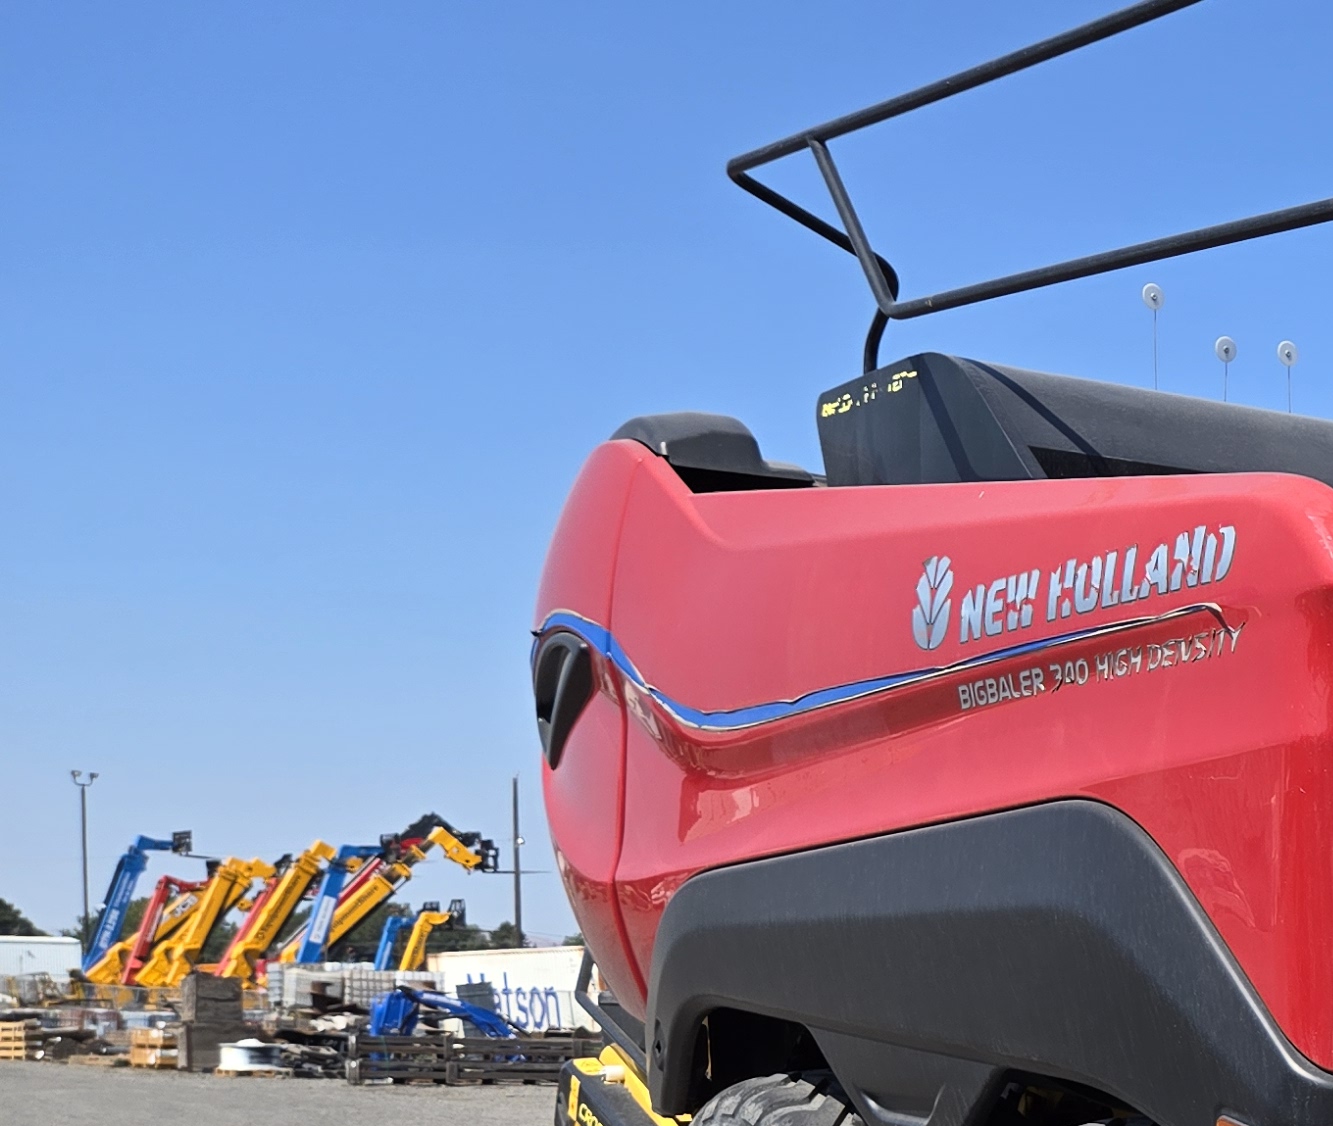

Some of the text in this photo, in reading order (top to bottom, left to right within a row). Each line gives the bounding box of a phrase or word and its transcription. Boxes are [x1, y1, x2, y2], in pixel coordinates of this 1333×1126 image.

[959, 524, 1237, 645] NEW HOLLAND
[958, 666, 1046, 710] BIGBALER
[1094, 645, 1143, 683] HIGH
[1146, 621, 1247, 672] DENSITY
